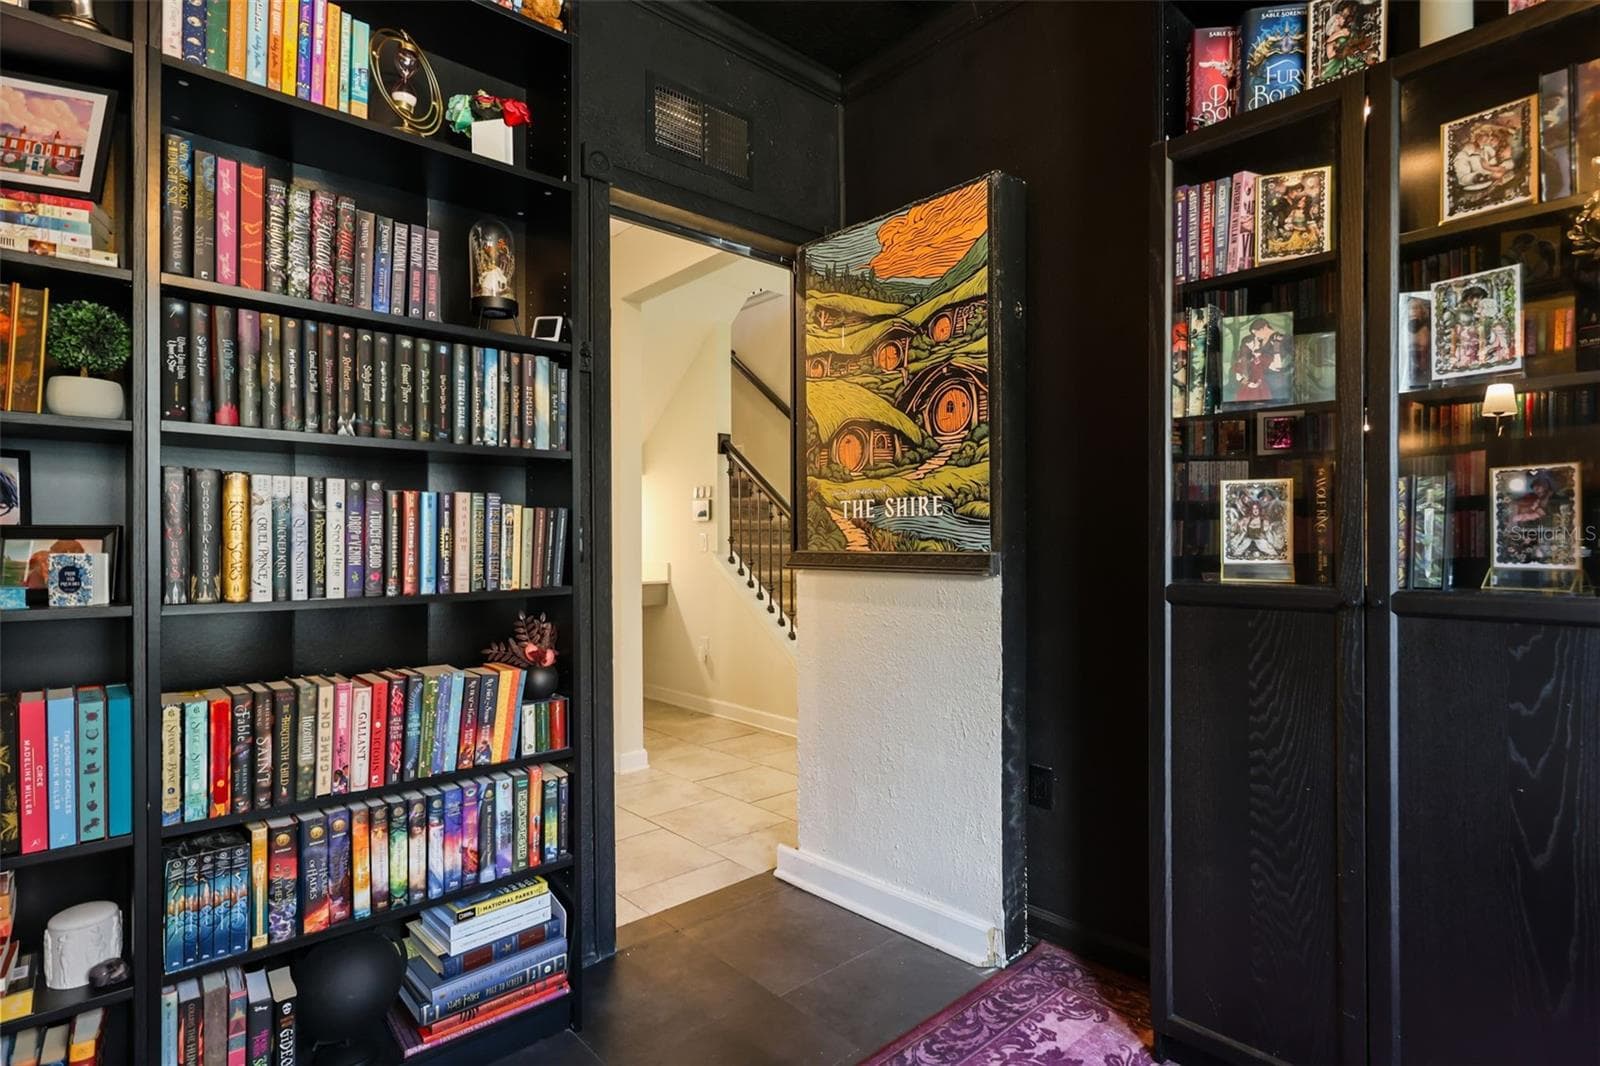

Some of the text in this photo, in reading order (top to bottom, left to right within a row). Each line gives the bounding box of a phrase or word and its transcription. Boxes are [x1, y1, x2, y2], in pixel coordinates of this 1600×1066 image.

[270, 205, 285, 272] BELLADONNA
[316, 221, 332, 271] FOXGLOVE
[1217, 222, 1226, 247] VILLAIN
[1232, 218, 1240, 244] VILLAIN
[394, 227, 406, 272] BELLADONNA
[427, 238, 438, 271] WISTERIA
[342, 356, 352, 391] Reflection
[400, 384, 412, 403] There
[201, 481, 212, 532] CROOKED
[1316, 477, 1327, 505] WOLF
[840, 496, 944, 519] THE SHIRE
[1314, 510, 1329, 533] KING
[228, 500, 244, 580] KING SCARS
[348, 516, 361, 534] DROP
[370, 515, 382, 538] TOUCH
[256, 517, 269, 580] CRUEL PRINCE
[274, 518, 286, 578] WICKED KING
[348, 541, 361, 565] VENOM
[370, 545, 382, 568] BLOOD
[296, 552, 304, 584] NOTHING
[234, 705, 250, 742] Fable
[280, 714, 291, 760] THIRTEENTH
[357, 712, 367, 760] GALLANT
[321, 712, 330, 772] GAME ON
[373, 730, 382, 771] VICIOUS
[24, 740, 32, 781] MADELINE
[65, 768, 71, 777] OF
[256, 737, 270, 783] SAINT
[280, 763, 289, 785] CHILD
[307, 869, 318, 900] HADES
[483, 891, 533, 912] NATIONAL PARKS
[188, 1027, 196, 1043] THE
